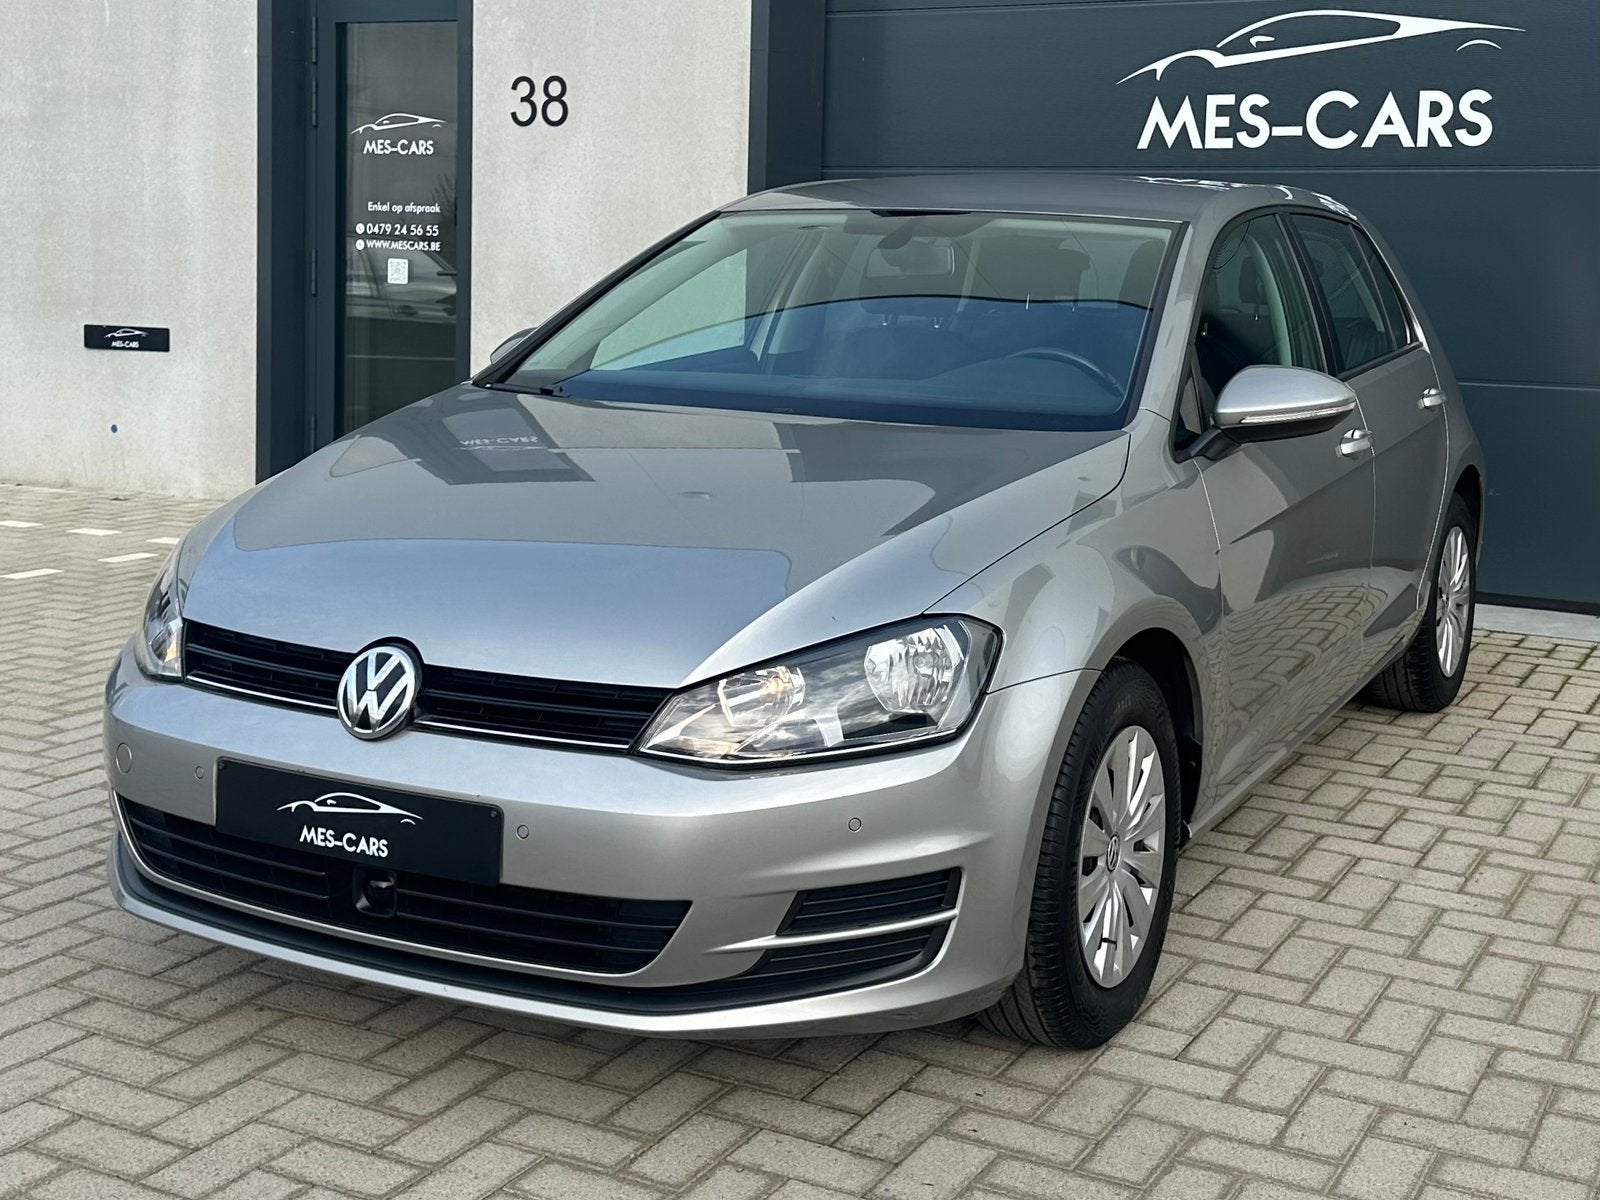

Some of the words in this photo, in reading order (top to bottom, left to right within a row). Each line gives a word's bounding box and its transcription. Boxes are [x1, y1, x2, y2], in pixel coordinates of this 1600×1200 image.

[511, 75, 568, 127] 38
[1136, 89, 1494, 150] MES-CARS
[363, 139, 434, 155] MES-CARS
[367, 201, 390, 212] Enkel
[391, 204, 403, 214] op
[404, 202, 441, 215] afspraak
[366, 222, 392, 235] 0479
[394, 223, 407, 235] 24
[410, 224, 423, 236] 56
[425, 225, 439, 236] 55
[366, 239, 441, 252] WWW.MESCARS.BE
[299, 824, 389, 858] MES-CARS
